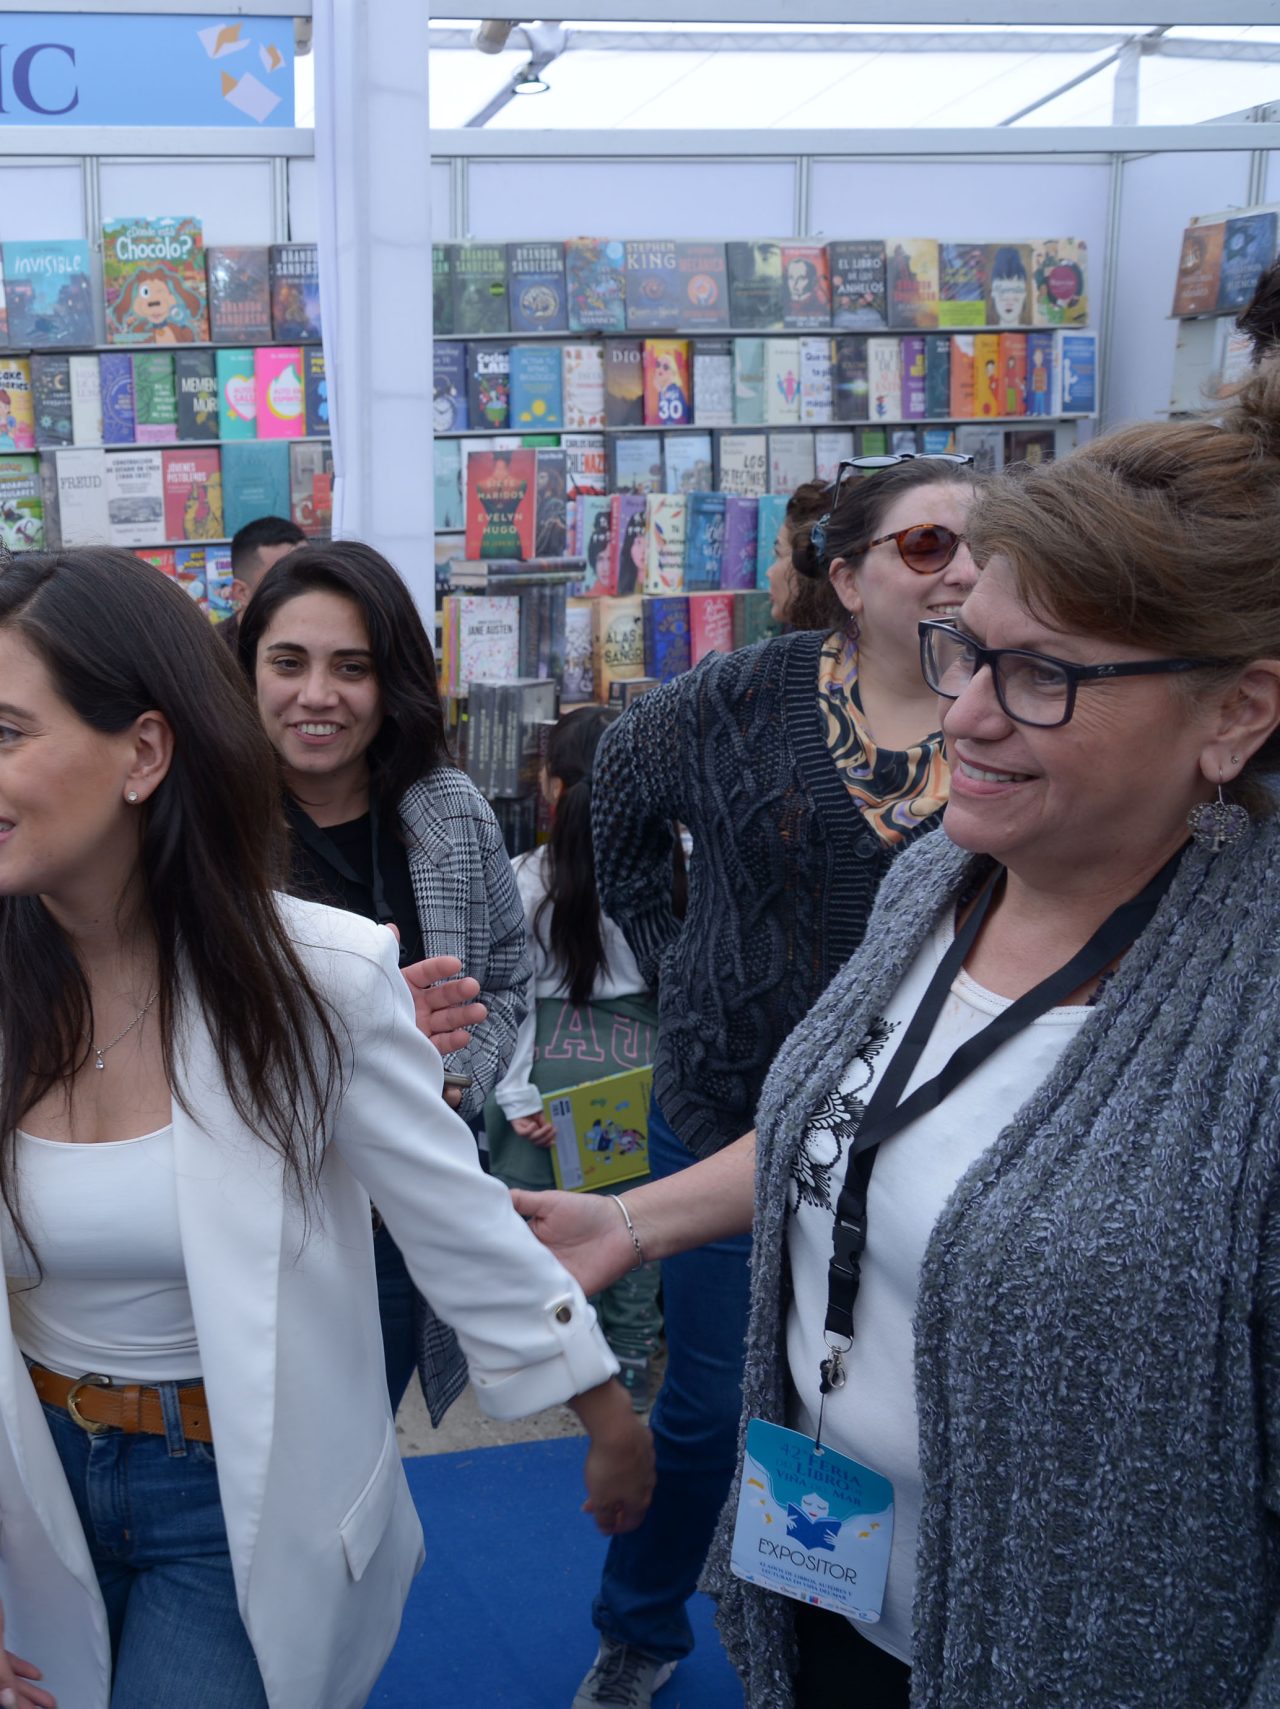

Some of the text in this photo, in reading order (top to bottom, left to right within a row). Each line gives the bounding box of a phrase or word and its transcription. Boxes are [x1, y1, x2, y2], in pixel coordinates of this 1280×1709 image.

[116, 236, 191, 260] Chocolo?
[281, 248, 319, 262] BRANDO
[15, 254, 82, 274] INVISIBLE
[276, 263, 318, 275] SANDERS
[627, 253, 677, 270] KING
[182, 376, 217, 392] MEMEN
[193, 397, 217, 413] MOR
[659, 400, 683, 419] 30
[60, 475, 102, 490] FREUD
[477, 512, 523, 523] EVELYN
[483, 525, 518, 535] HUGO
[606, 629, 636, 643] ALAS
[605, 650, 643, 663] SANGR
[796, 1462, 849, 1492] LIBRO
[758, 1537, 858, 1585] EXPOSITOR
